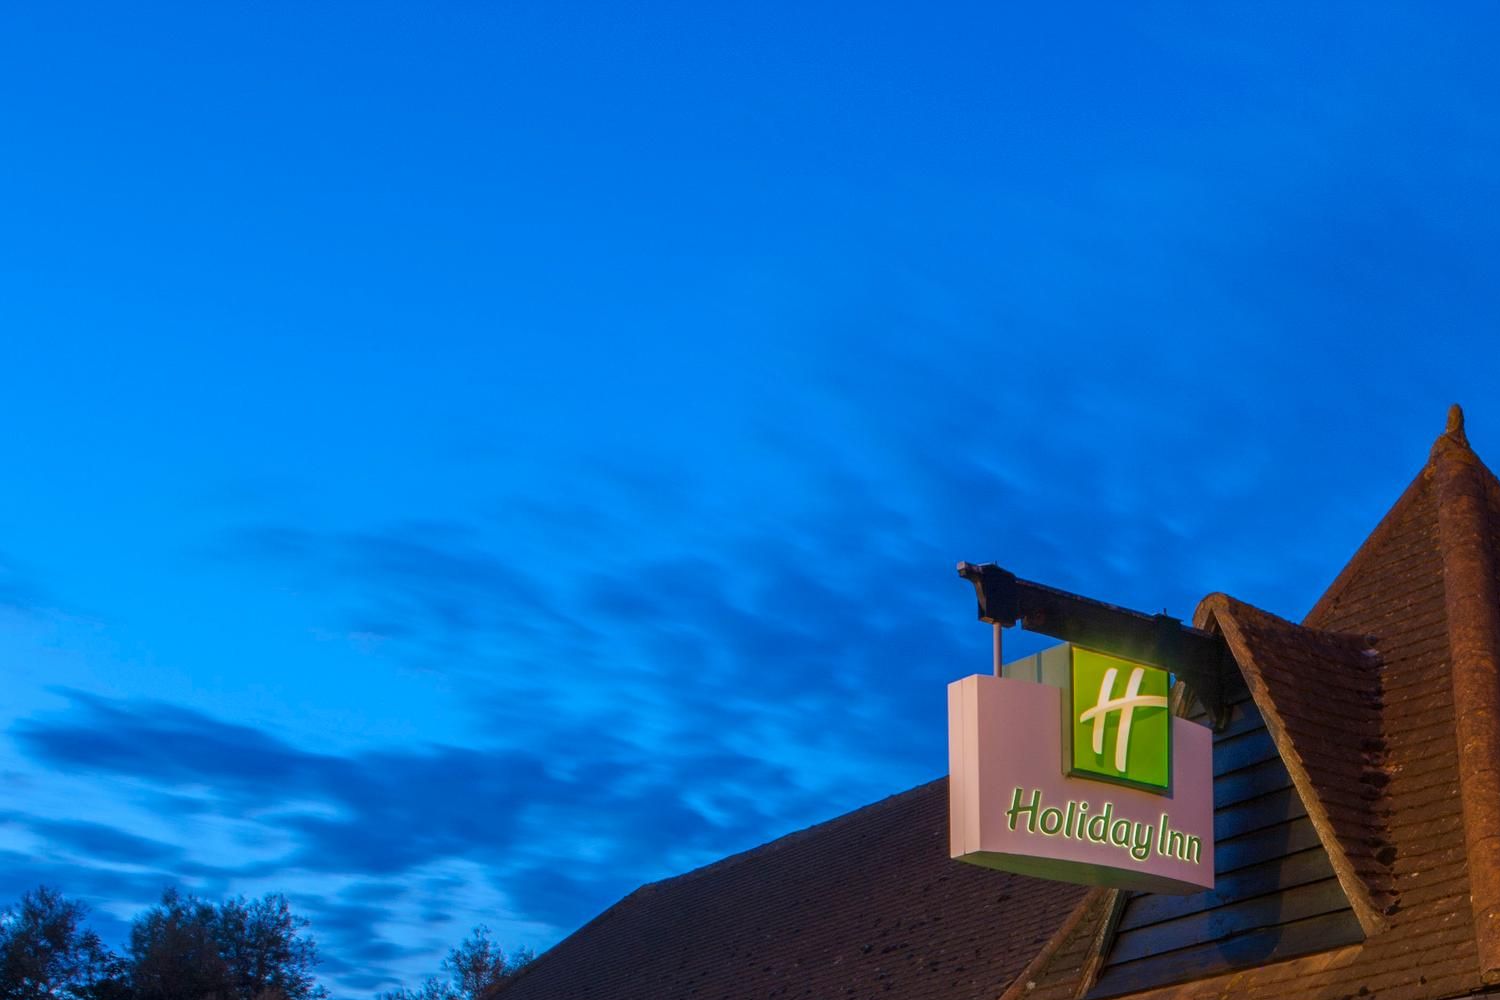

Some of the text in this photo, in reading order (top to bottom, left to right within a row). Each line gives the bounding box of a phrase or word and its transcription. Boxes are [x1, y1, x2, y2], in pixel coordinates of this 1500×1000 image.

[1080, 667, 1168, 773] H
[1005, 786, 1201, 864] Holiday Inn
